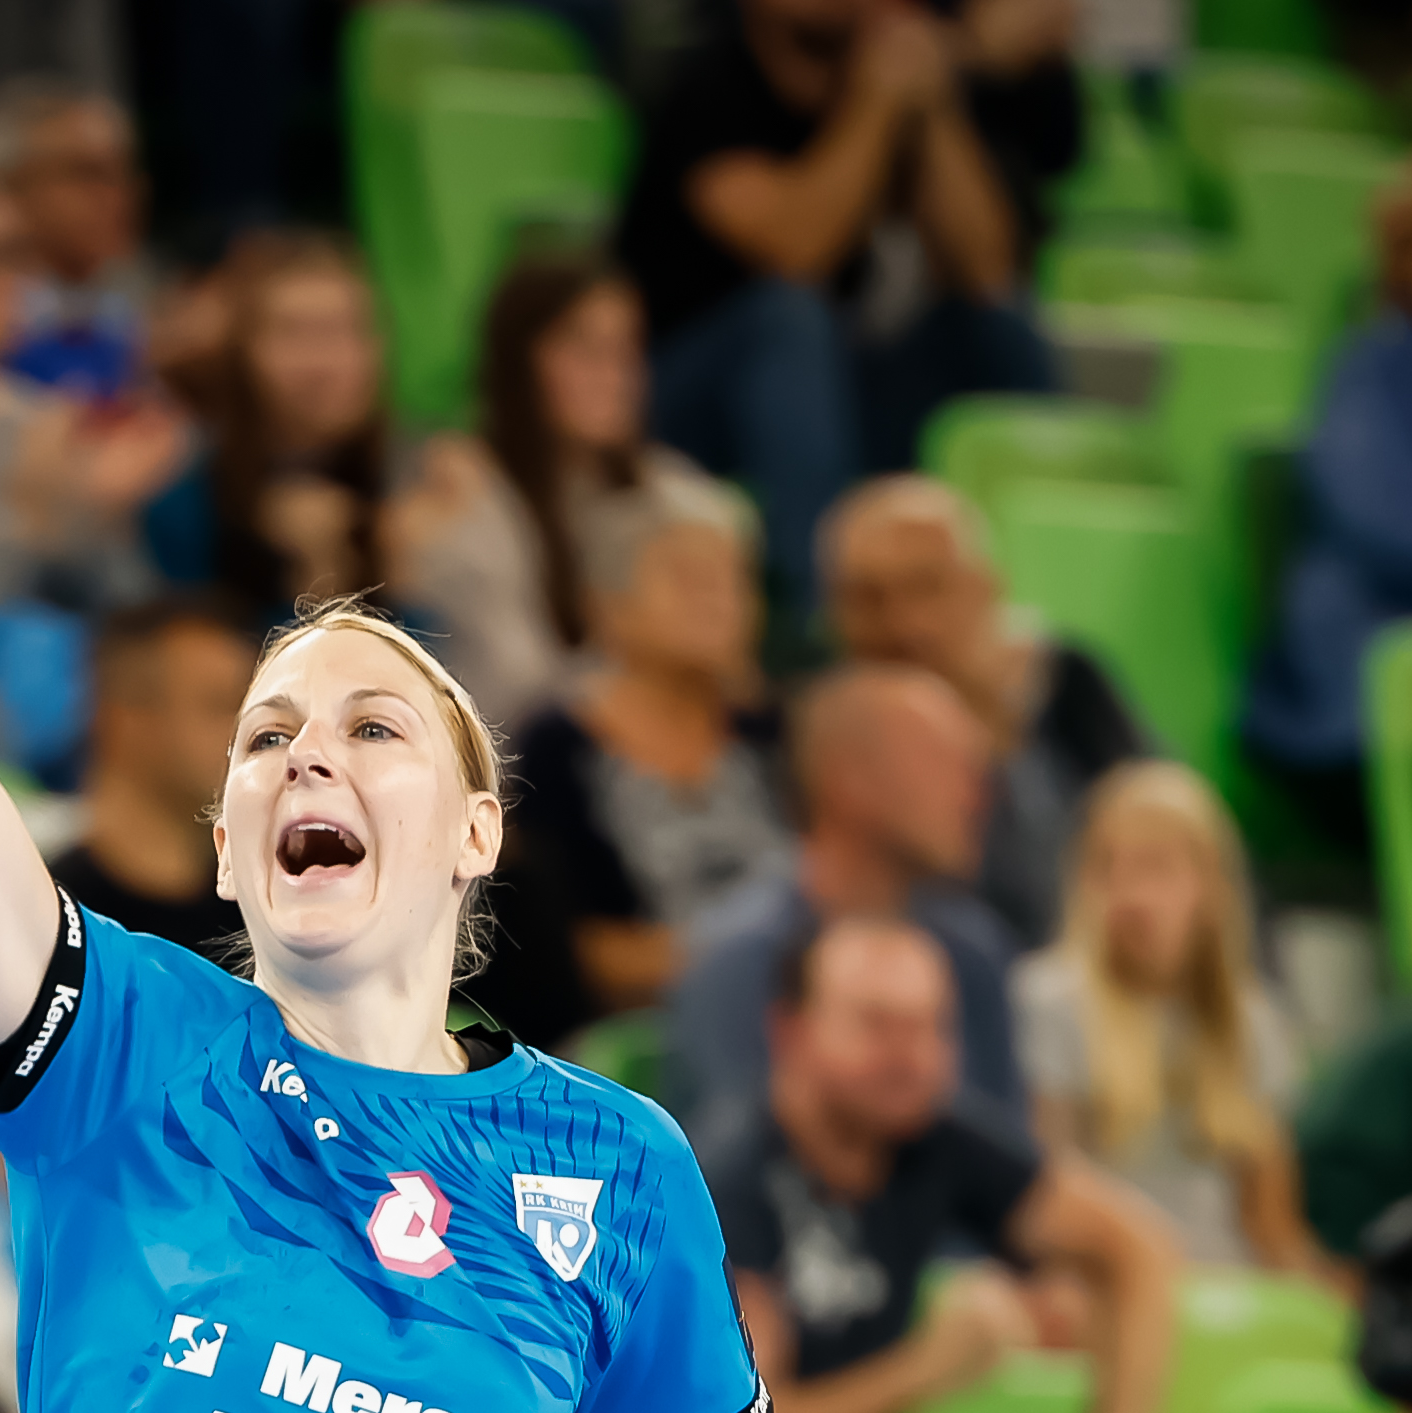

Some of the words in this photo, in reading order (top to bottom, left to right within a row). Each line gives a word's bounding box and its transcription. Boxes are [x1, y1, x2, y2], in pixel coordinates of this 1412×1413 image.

[15, 984, 80, 1077] Kempa
[525, 1193, 546, 1207] RK
[550, 1197, 584, 1218] KRIM
